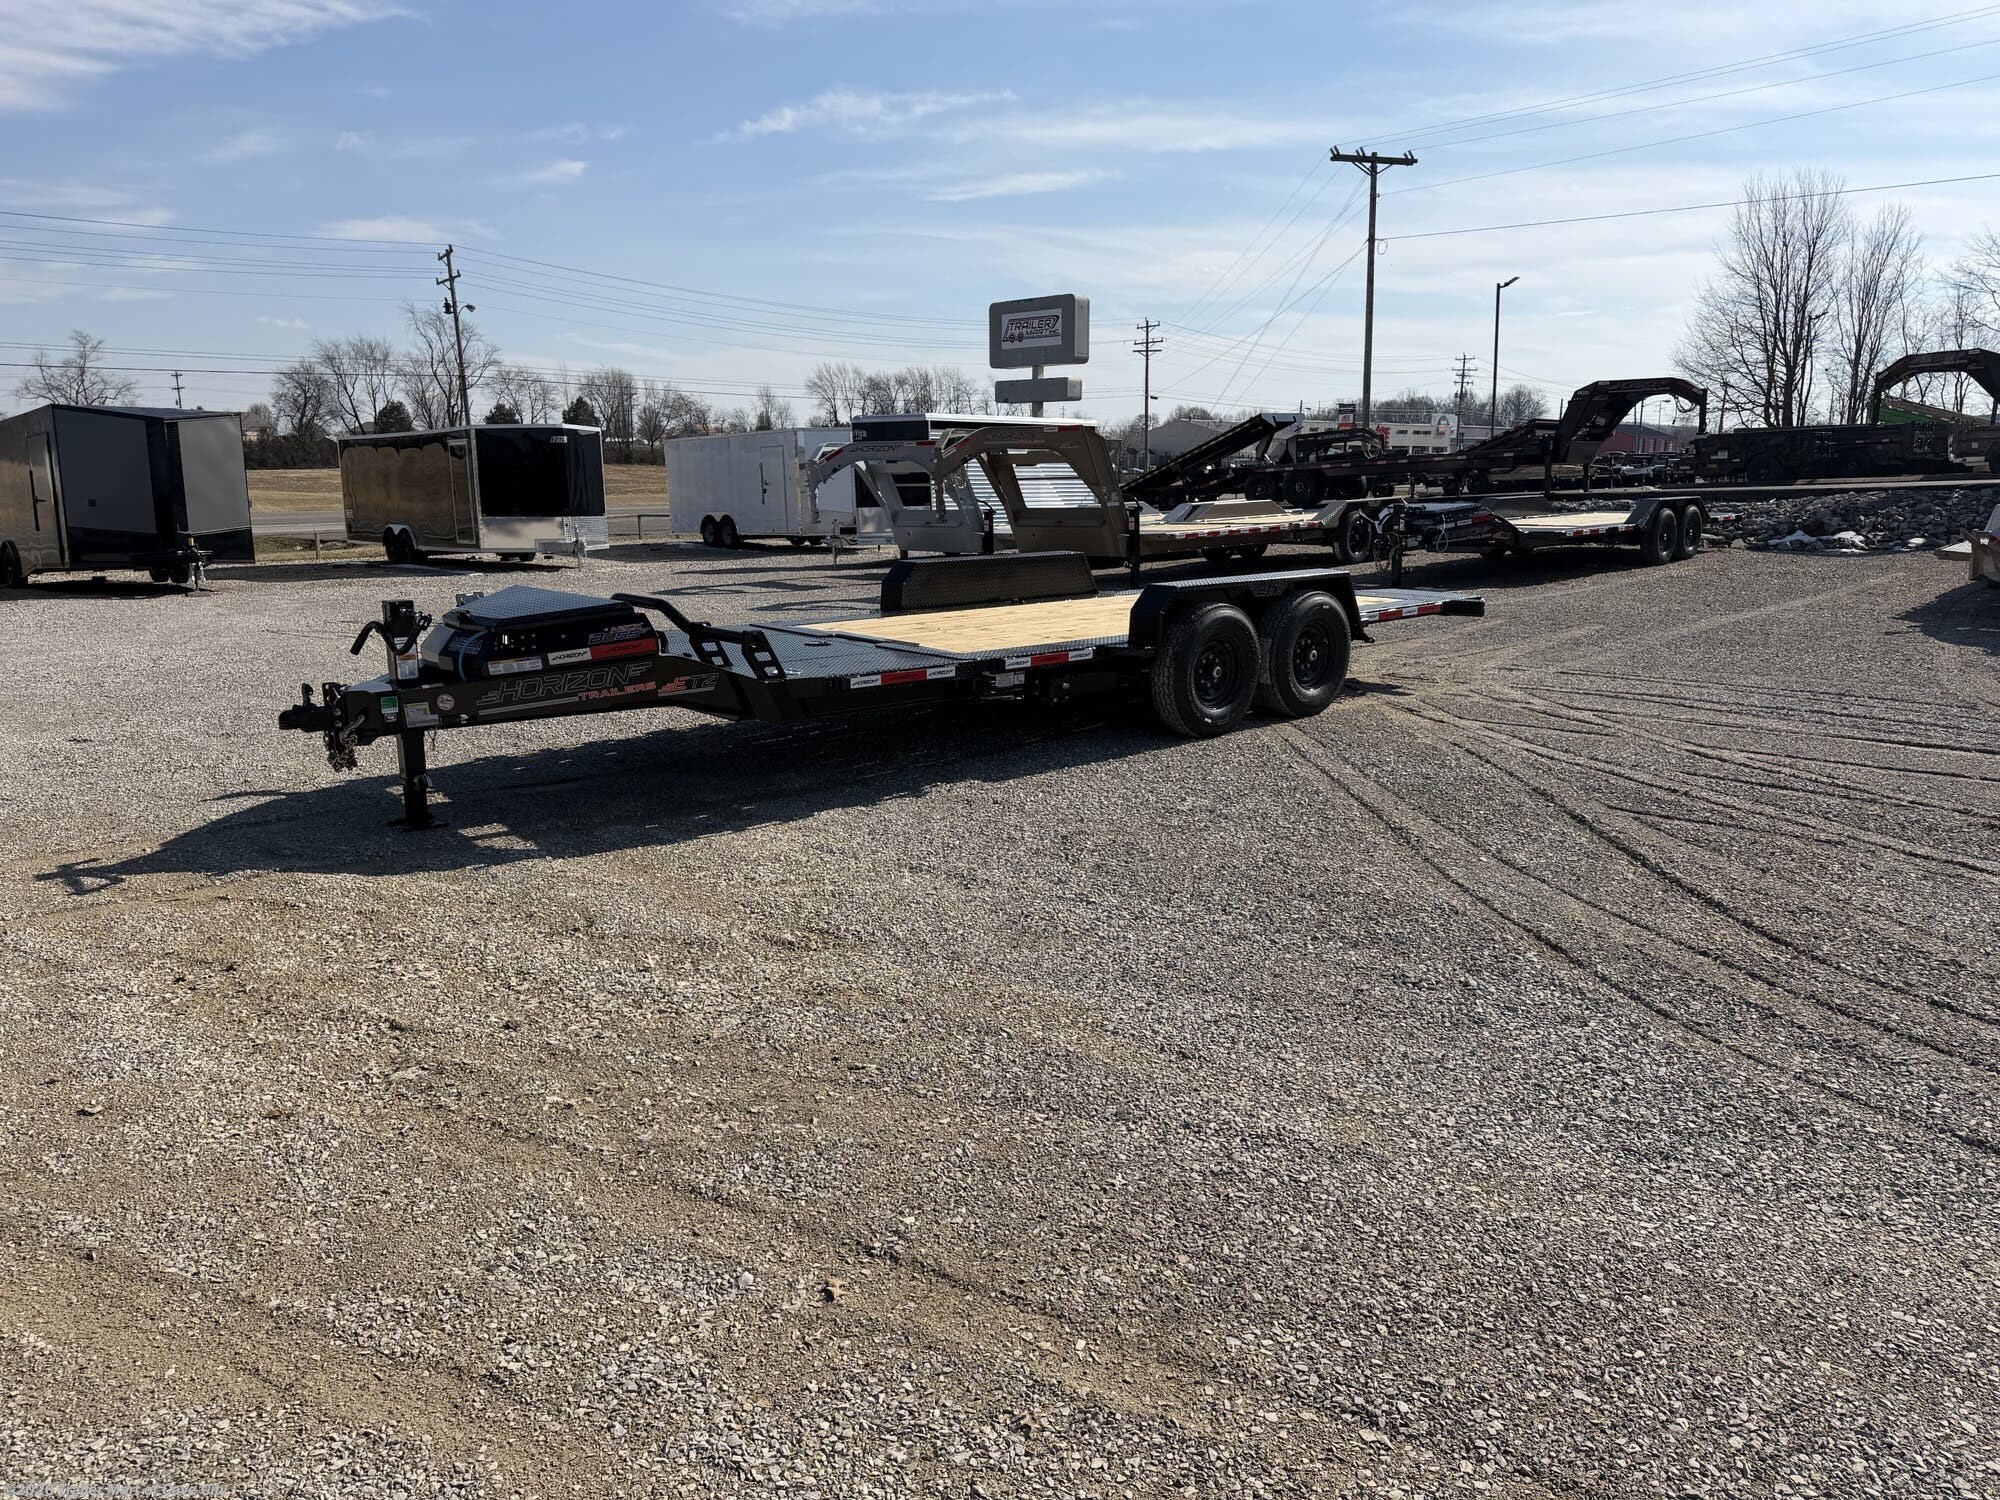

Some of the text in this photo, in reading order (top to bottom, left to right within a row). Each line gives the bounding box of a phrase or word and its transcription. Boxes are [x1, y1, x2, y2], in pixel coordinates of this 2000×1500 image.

[1010, 319, 1052, 330] TRAILER
[852, 443, 898, 452] HORIZON
[496, 663, 635, 702] HORIZON
[578, 681, 656, 700] TRAILERS
